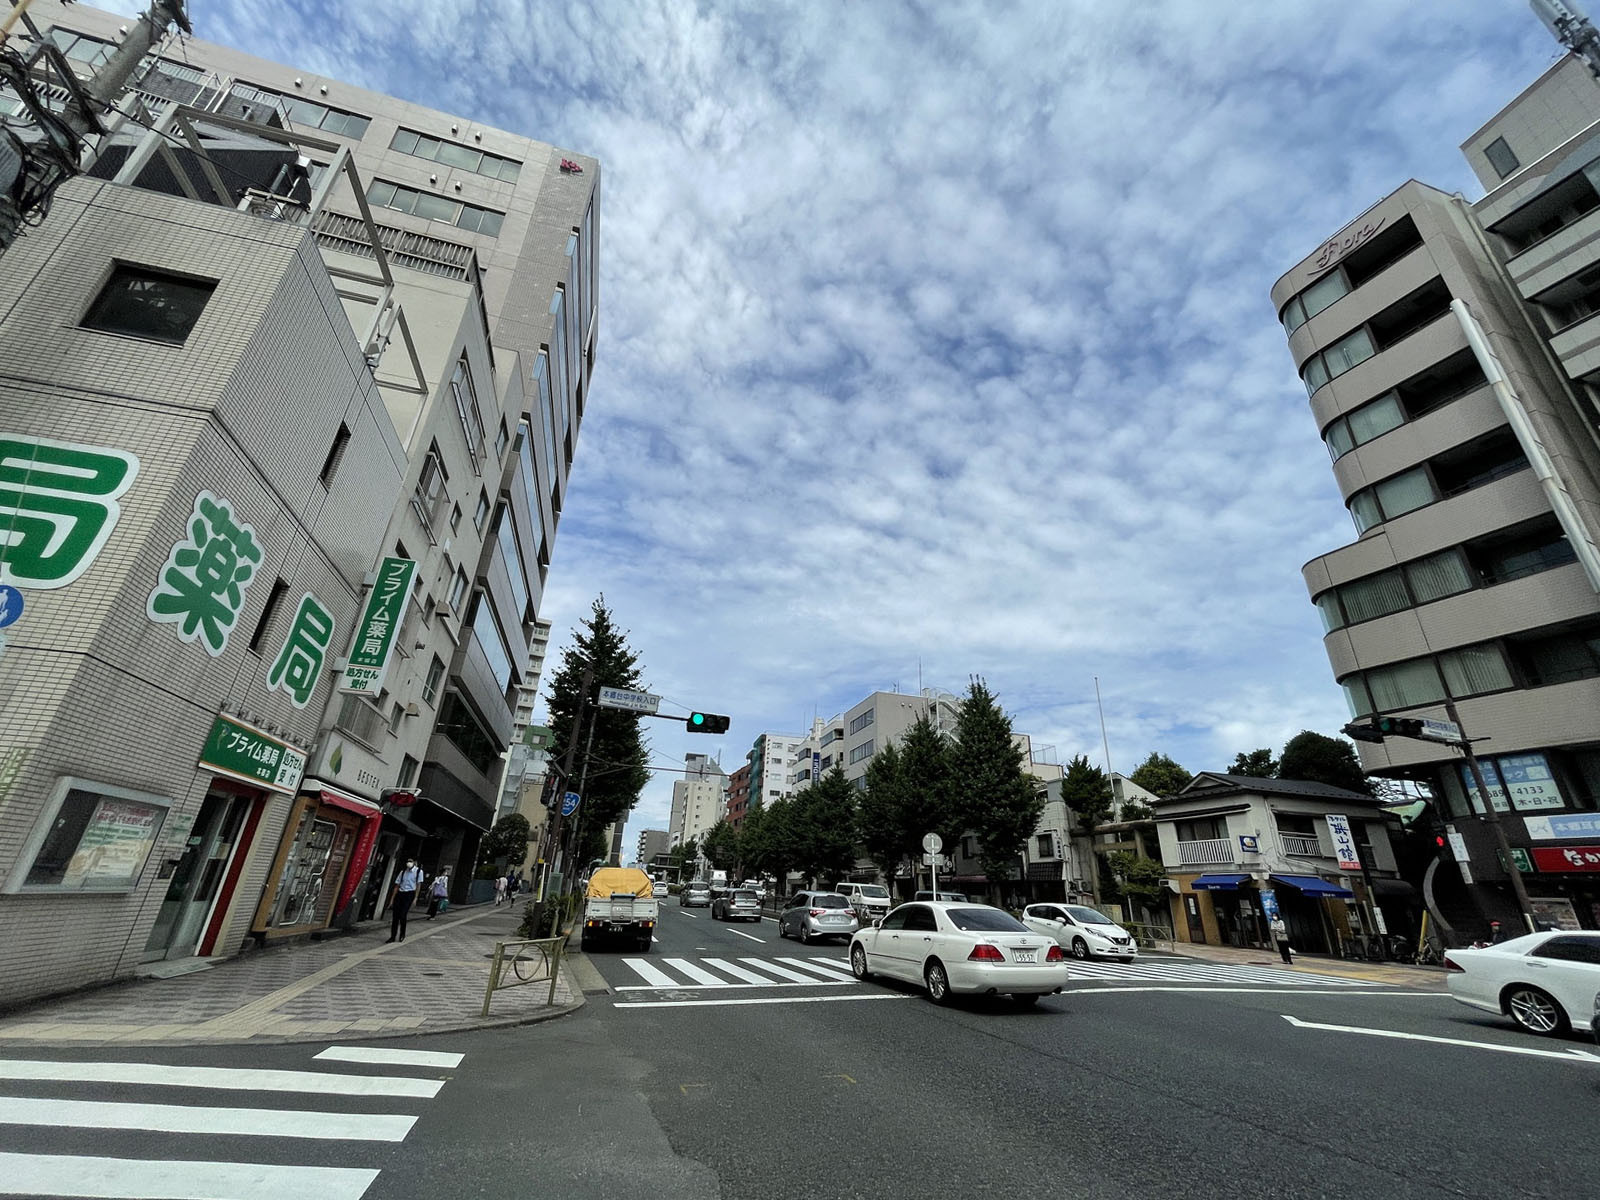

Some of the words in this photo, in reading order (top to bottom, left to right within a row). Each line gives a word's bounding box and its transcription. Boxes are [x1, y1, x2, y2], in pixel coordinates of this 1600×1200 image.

[360, 562, 409, 657] プライム薬局
[345, 667, 379, 680] 処方せん
[350, 678, 368, 690] 受付
[227, 732, 280, 767] プライム薬局
